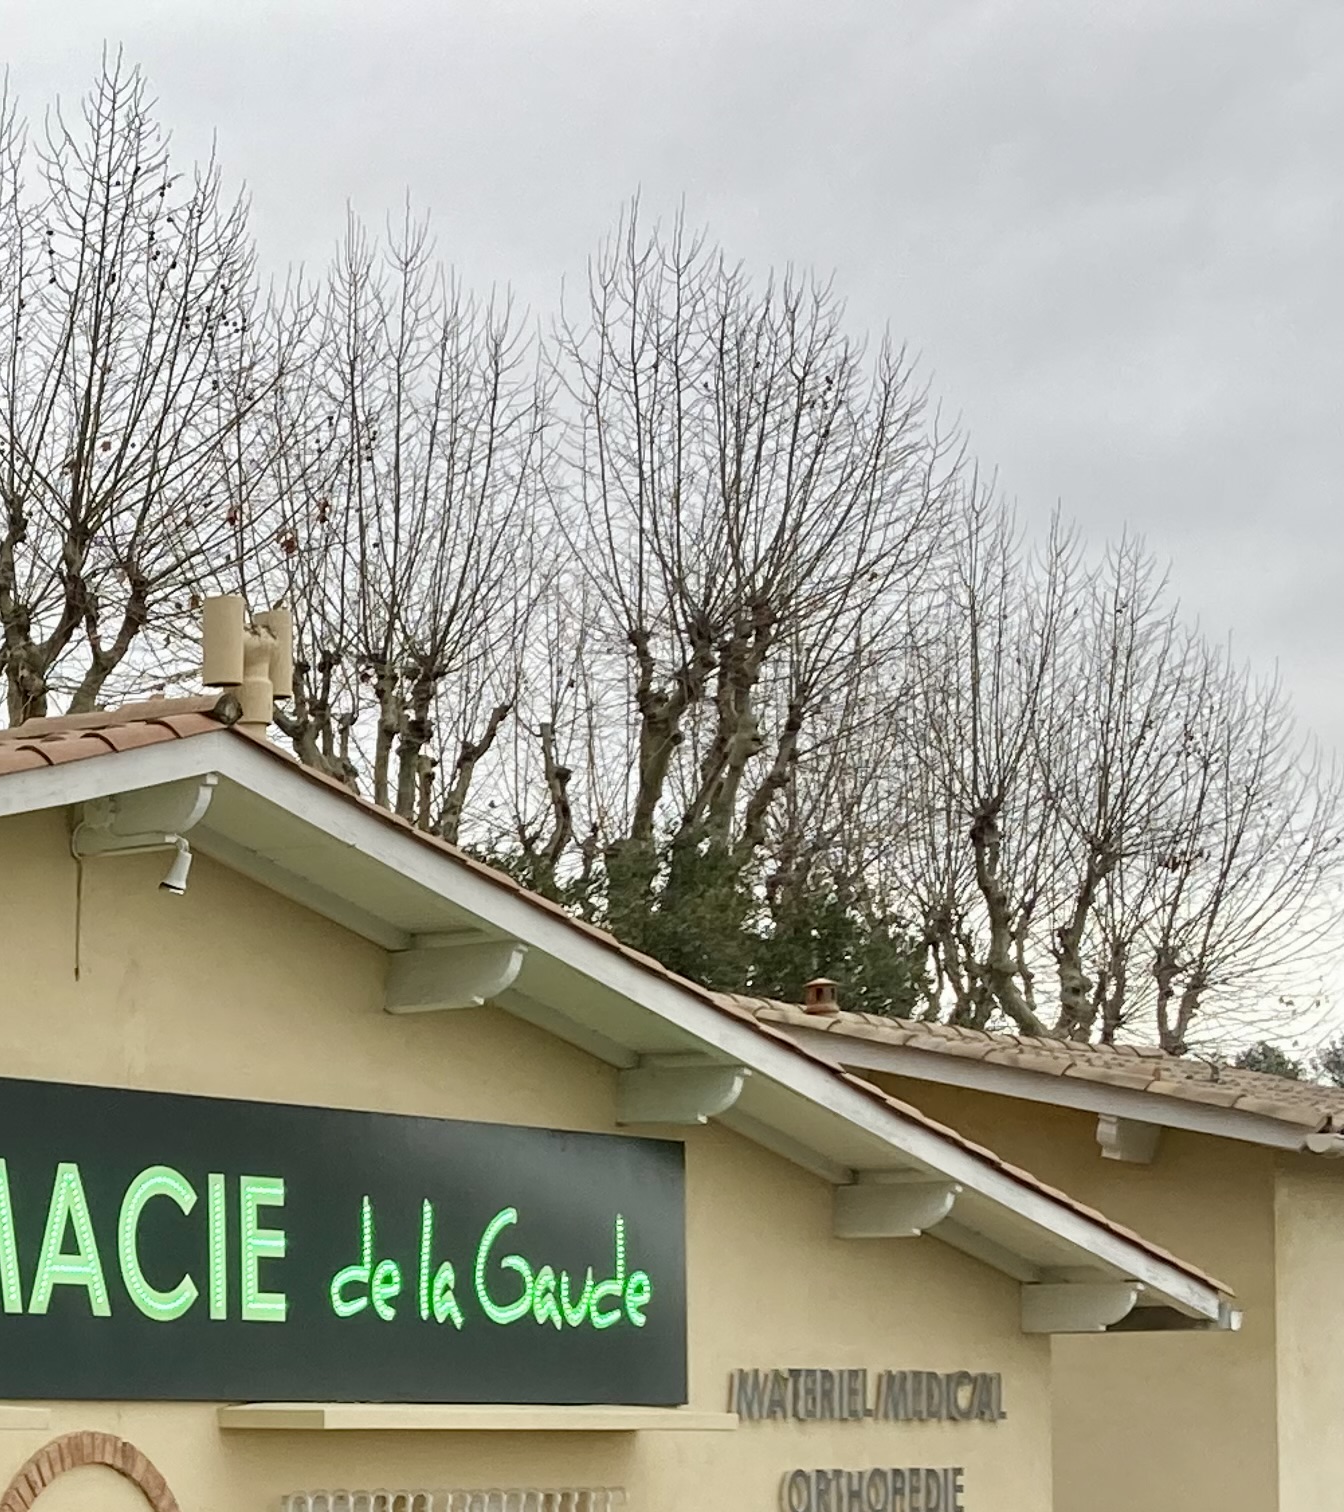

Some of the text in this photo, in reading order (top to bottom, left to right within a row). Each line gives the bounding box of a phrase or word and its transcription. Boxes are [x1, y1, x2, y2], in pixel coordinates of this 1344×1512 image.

[329, 1195, 401, 1322] de
[419, 1197, 464, 1330] la
[474, 1206, 652, 1330] Gaude
[727, 1367, 1007, 1423] MATERIEL MEDICAL
